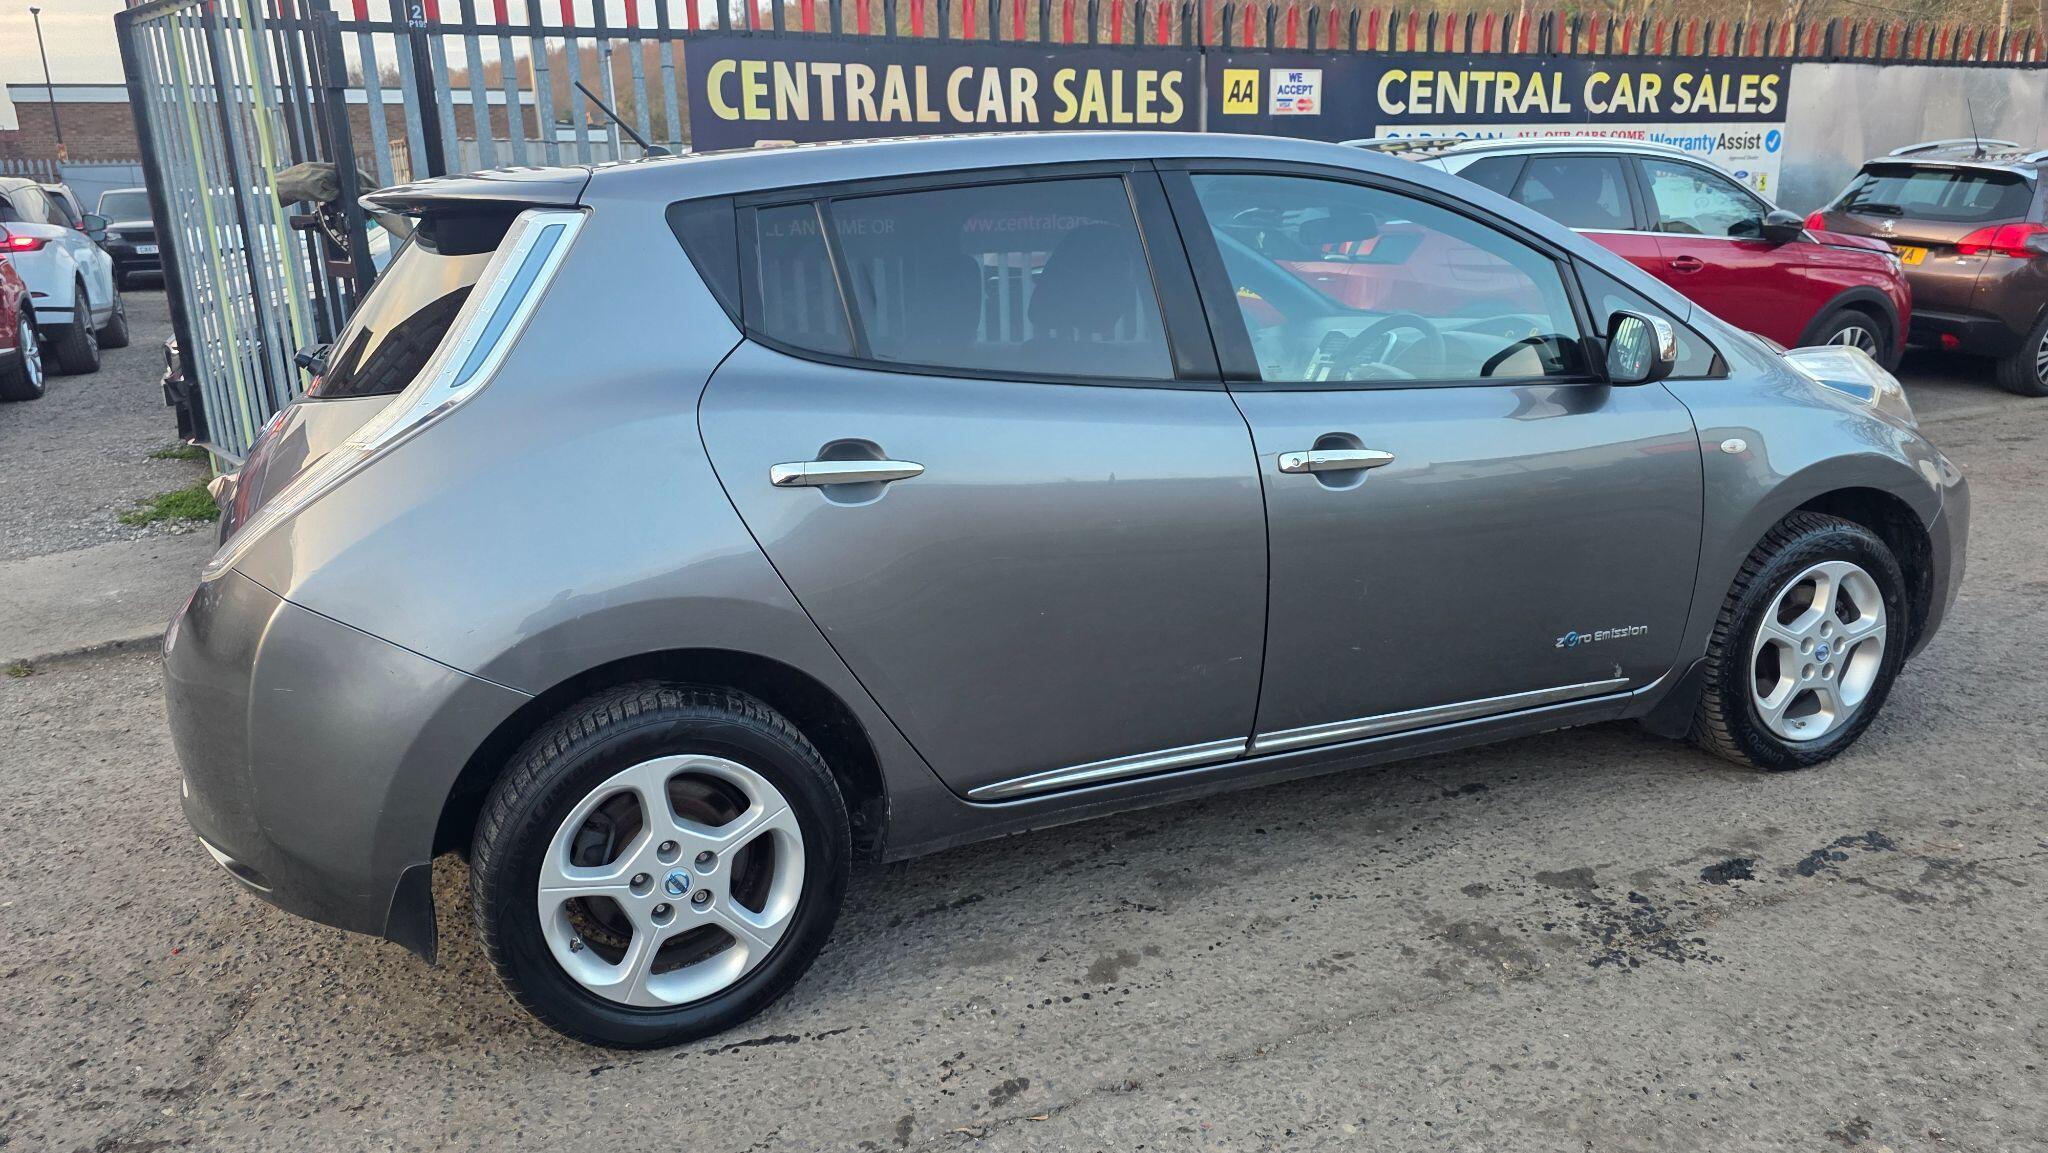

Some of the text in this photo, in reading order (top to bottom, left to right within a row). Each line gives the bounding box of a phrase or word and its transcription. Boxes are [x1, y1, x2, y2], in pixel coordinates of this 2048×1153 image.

[411, 5, 422, 19] 2
[1288, 72, 1303, 83] WE
[707, 58, 1184, 124] CENTRAL CAR SALES
[1228, 79, 1253, 103] AA
[1277, 85, 1314, 96] ACCEPT
[1377, 69, 1780, 115] CENTRAL CAR SALES
[1610, 130, 1646, 141] COME
